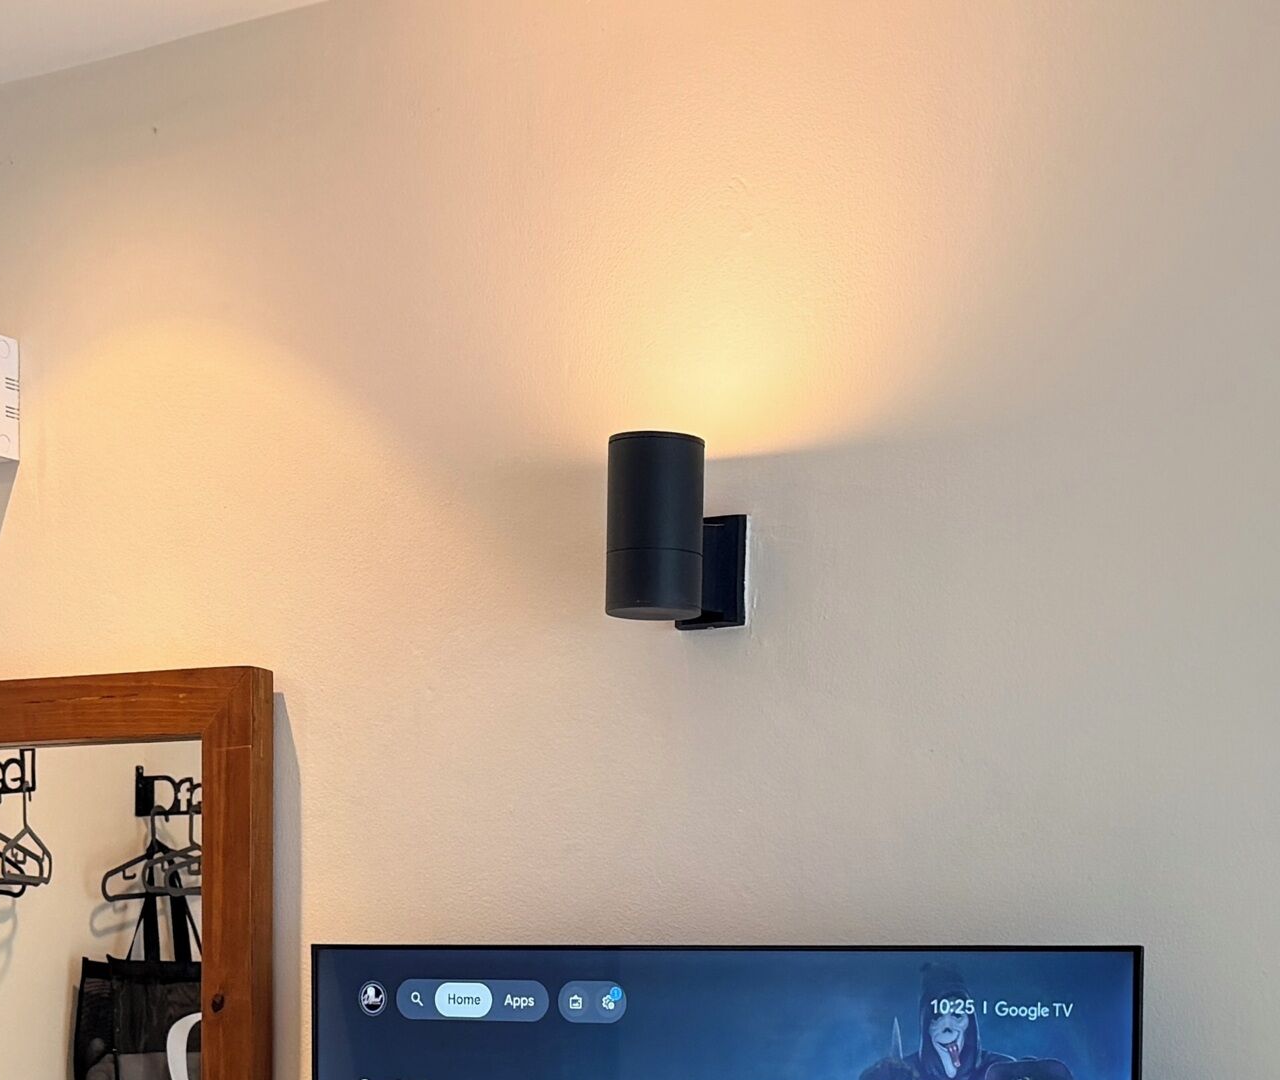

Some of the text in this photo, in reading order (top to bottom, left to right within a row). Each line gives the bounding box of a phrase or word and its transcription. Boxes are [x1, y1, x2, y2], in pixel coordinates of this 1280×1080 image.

[447, 993, 481, 1005] Home
[504, 994, 535, 1010] Apps
[930, 998, 1073, 1021] 10:25 Google TV
